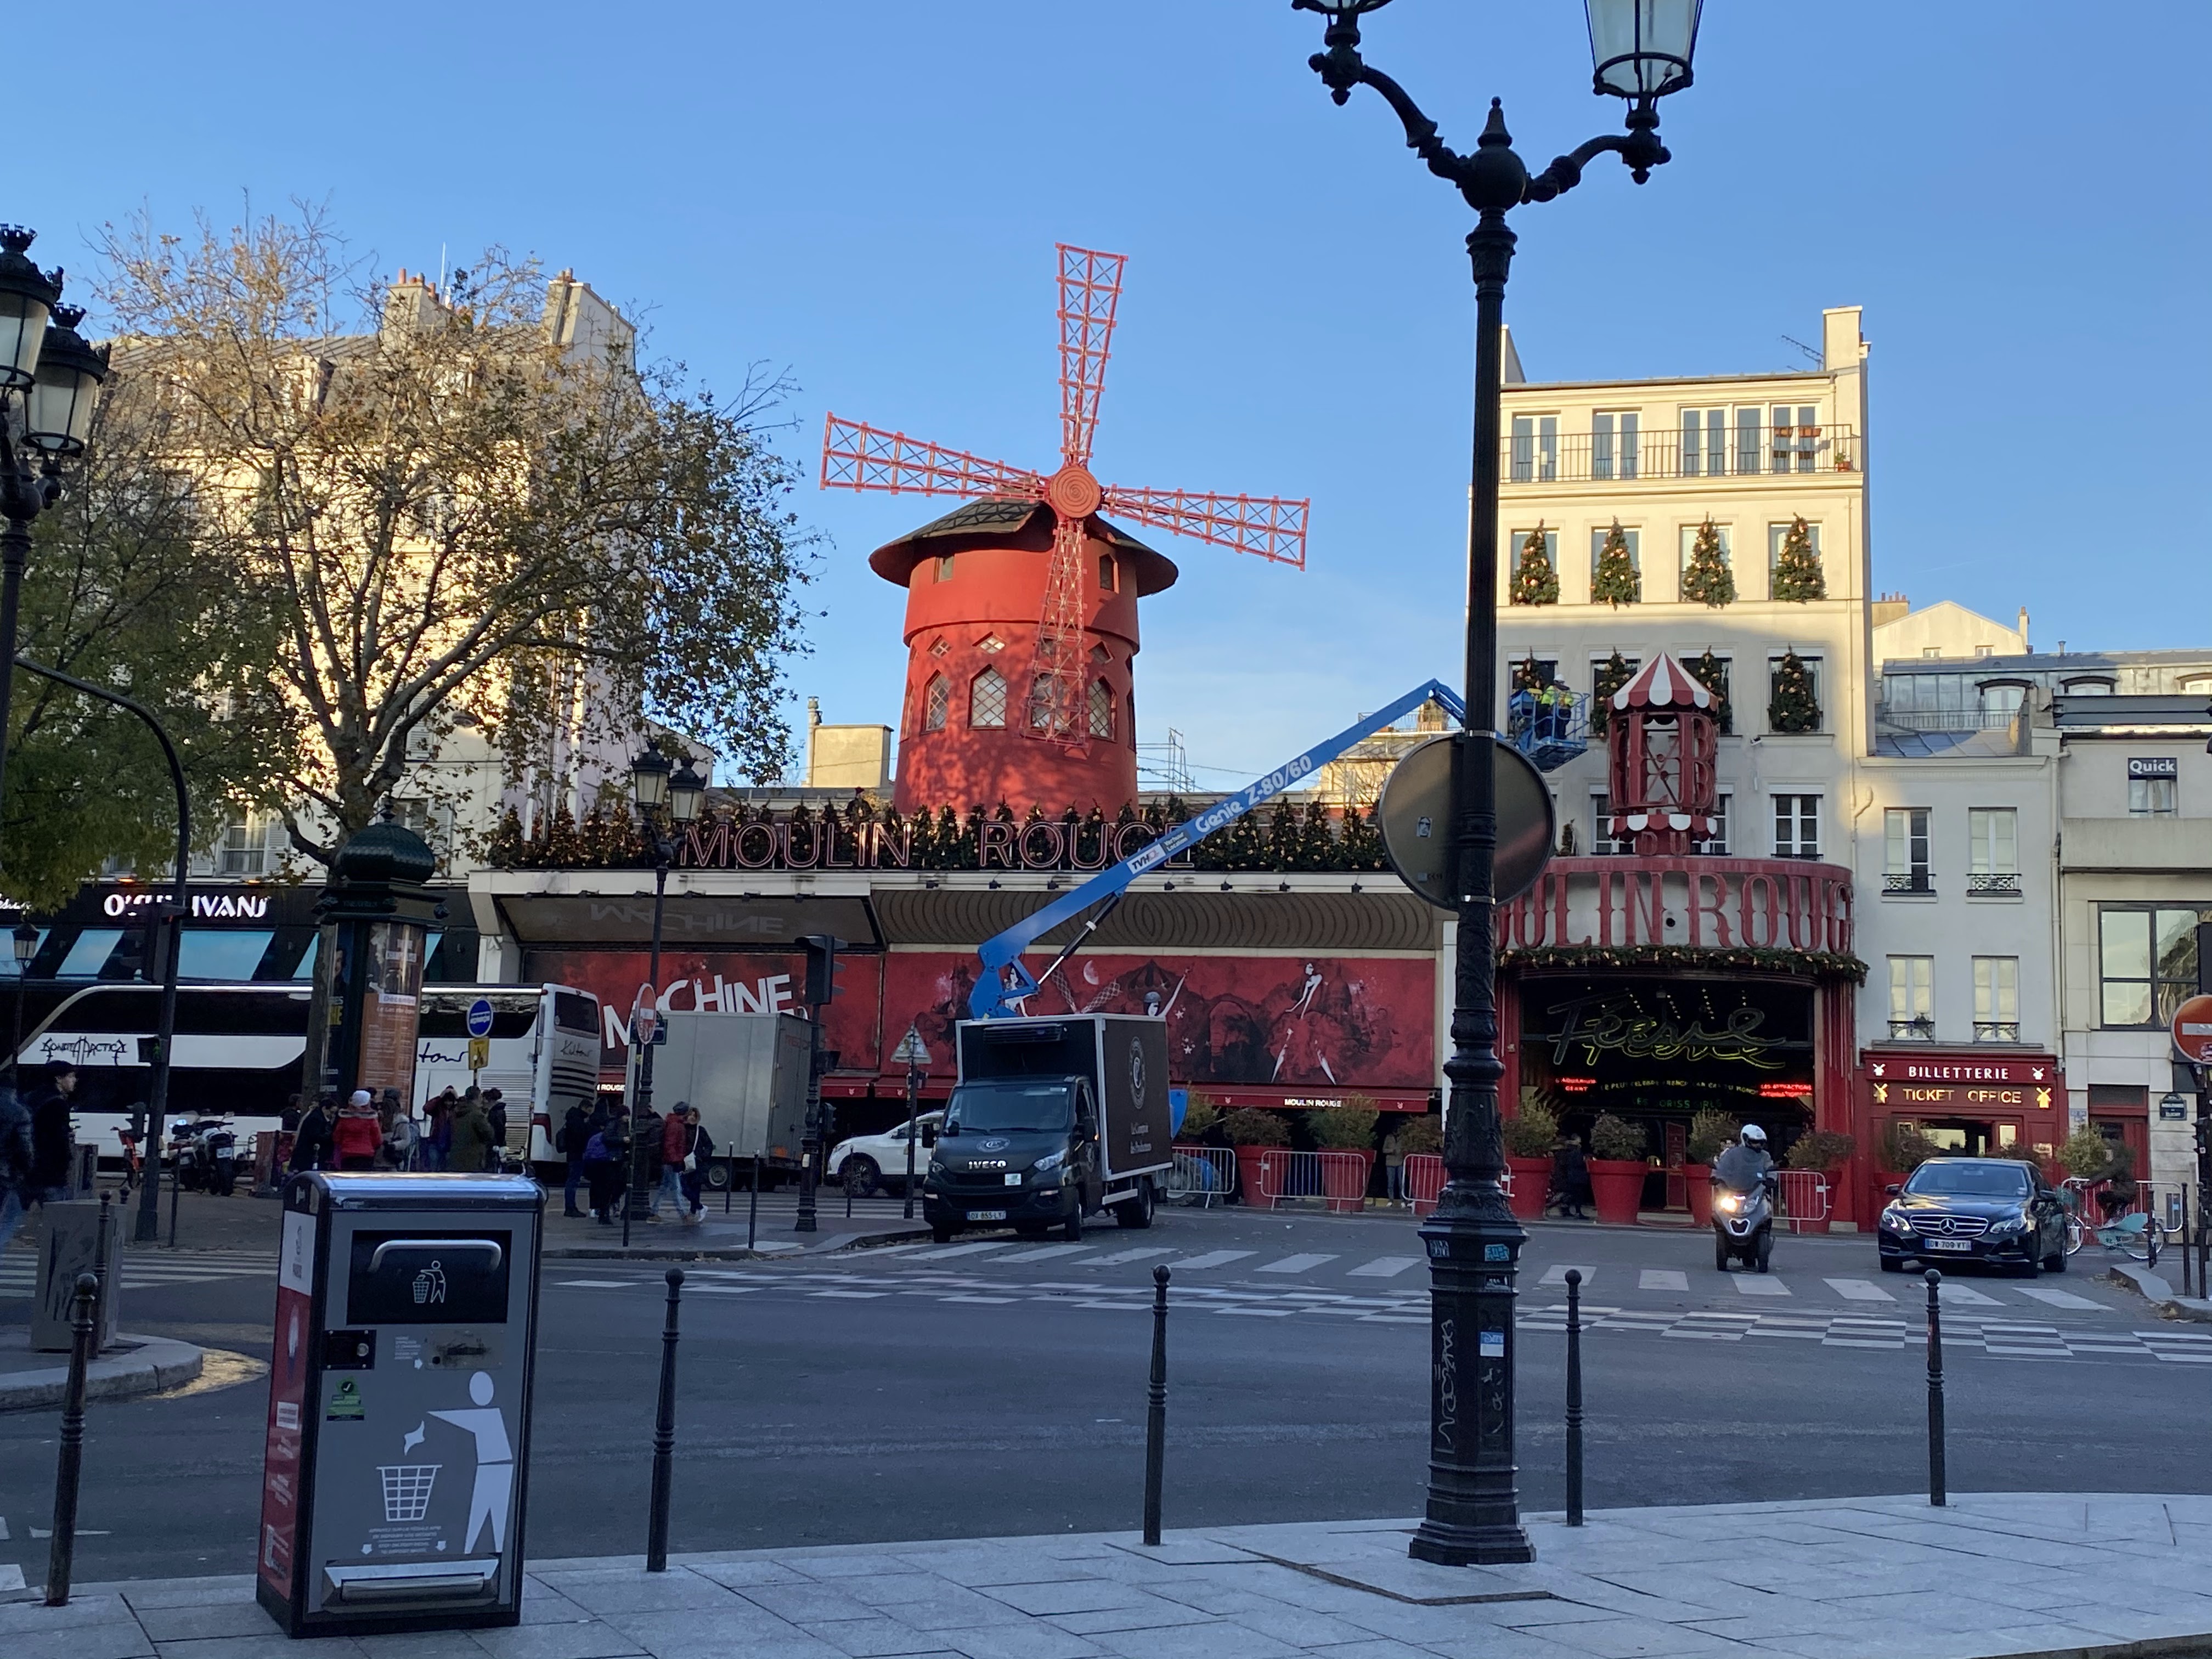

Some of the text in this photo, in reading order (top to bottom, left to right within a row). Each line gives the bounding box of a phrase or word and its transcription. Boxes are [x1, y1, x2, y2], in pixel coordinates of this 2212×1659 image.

[2129, 759, 2175, 775] Quick
[1195, 755, 1312, 833] Genie Z-80/60
[680, 822, 912, 867] MOULIN
[1131, 854, 1150, 870] TVH
[104, 894, 268, 917] O'IVANS
[1493, 871, 1666, 950] ULIN
[603, 974, 794, 1049] MCHINE
[1908, 1066, 2010, 1080] BILLETTERIE
[1284, 1098, 1314, 1107] MOULIN
[1903, 1088, 2022, 1104] TICKET OFFICE
[968, 1160, 1007, 1170] IVECO
